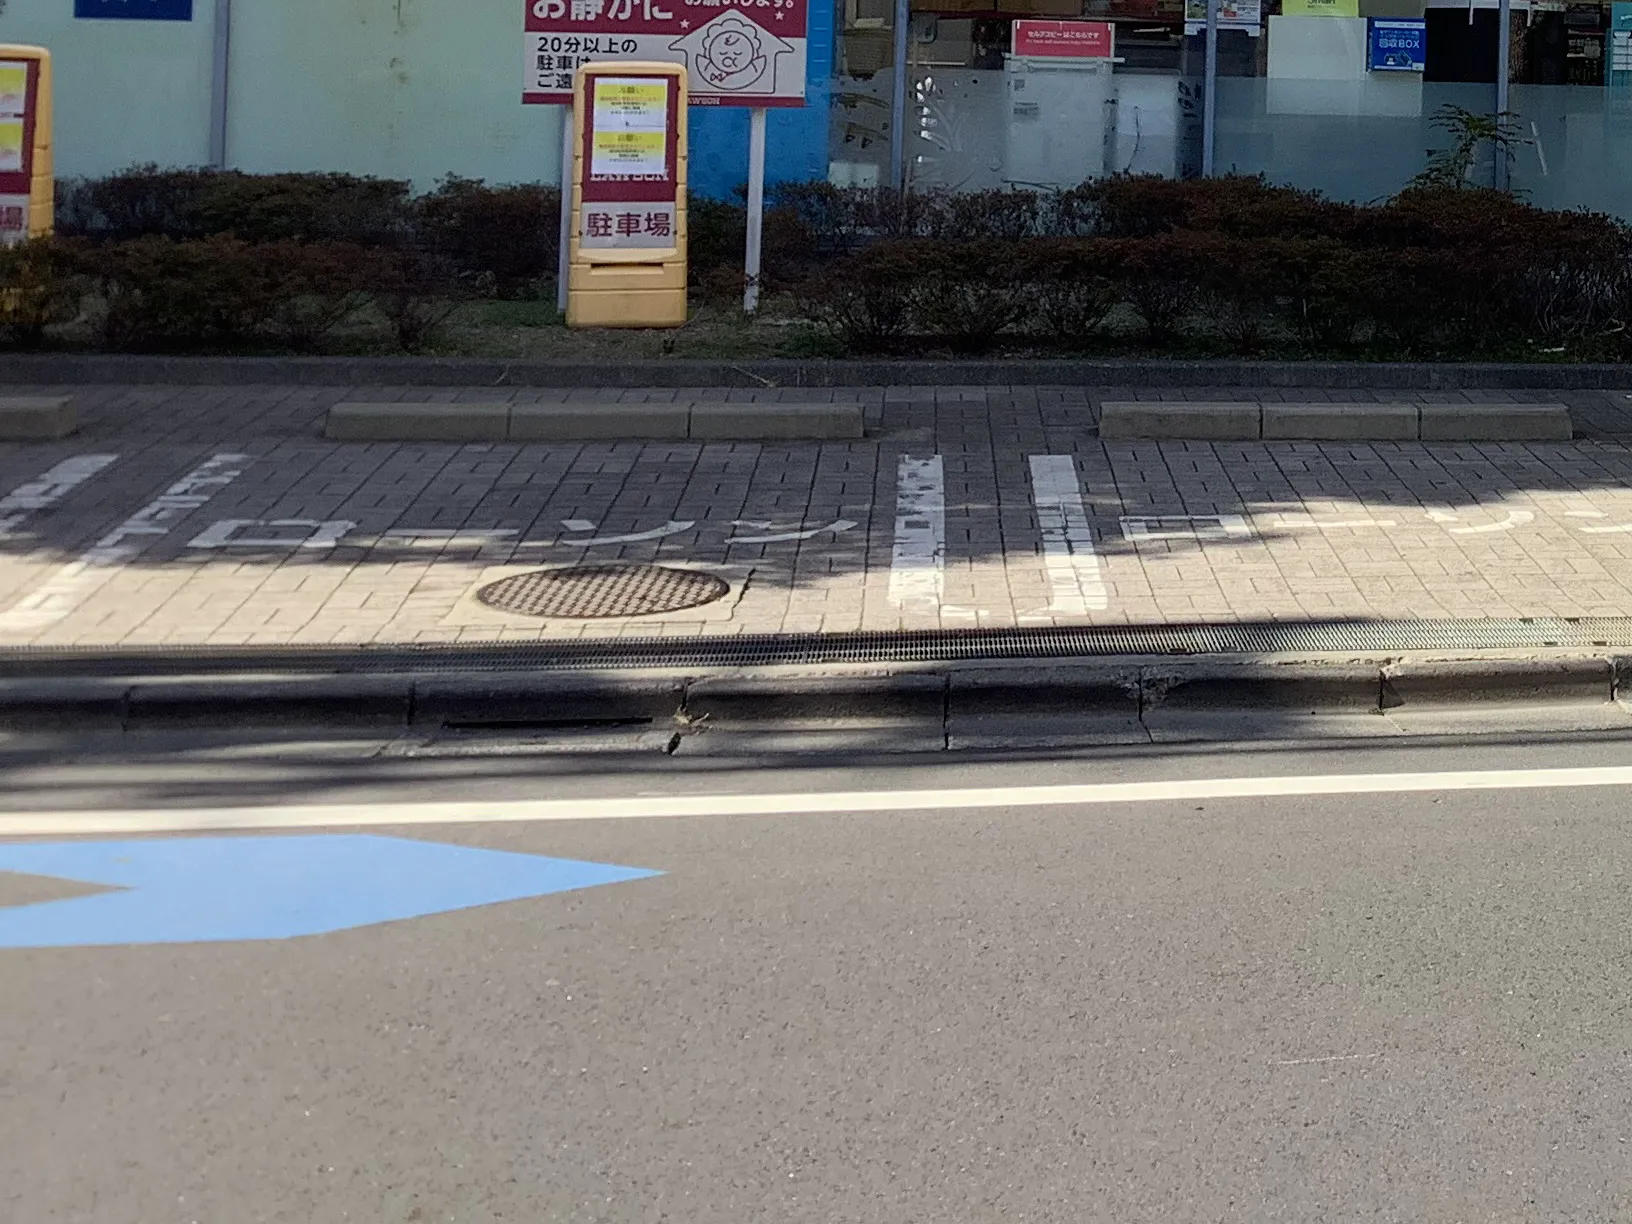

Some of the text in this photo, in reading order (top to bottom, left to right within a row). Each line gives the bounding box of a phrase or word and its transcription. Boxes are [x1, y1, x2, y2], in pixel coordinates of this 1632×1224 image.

[537, 36, 638, 54] 20分以上の
[688, 97, 720, 105] WSON
[586, 212, 671, 238] 駐車場
